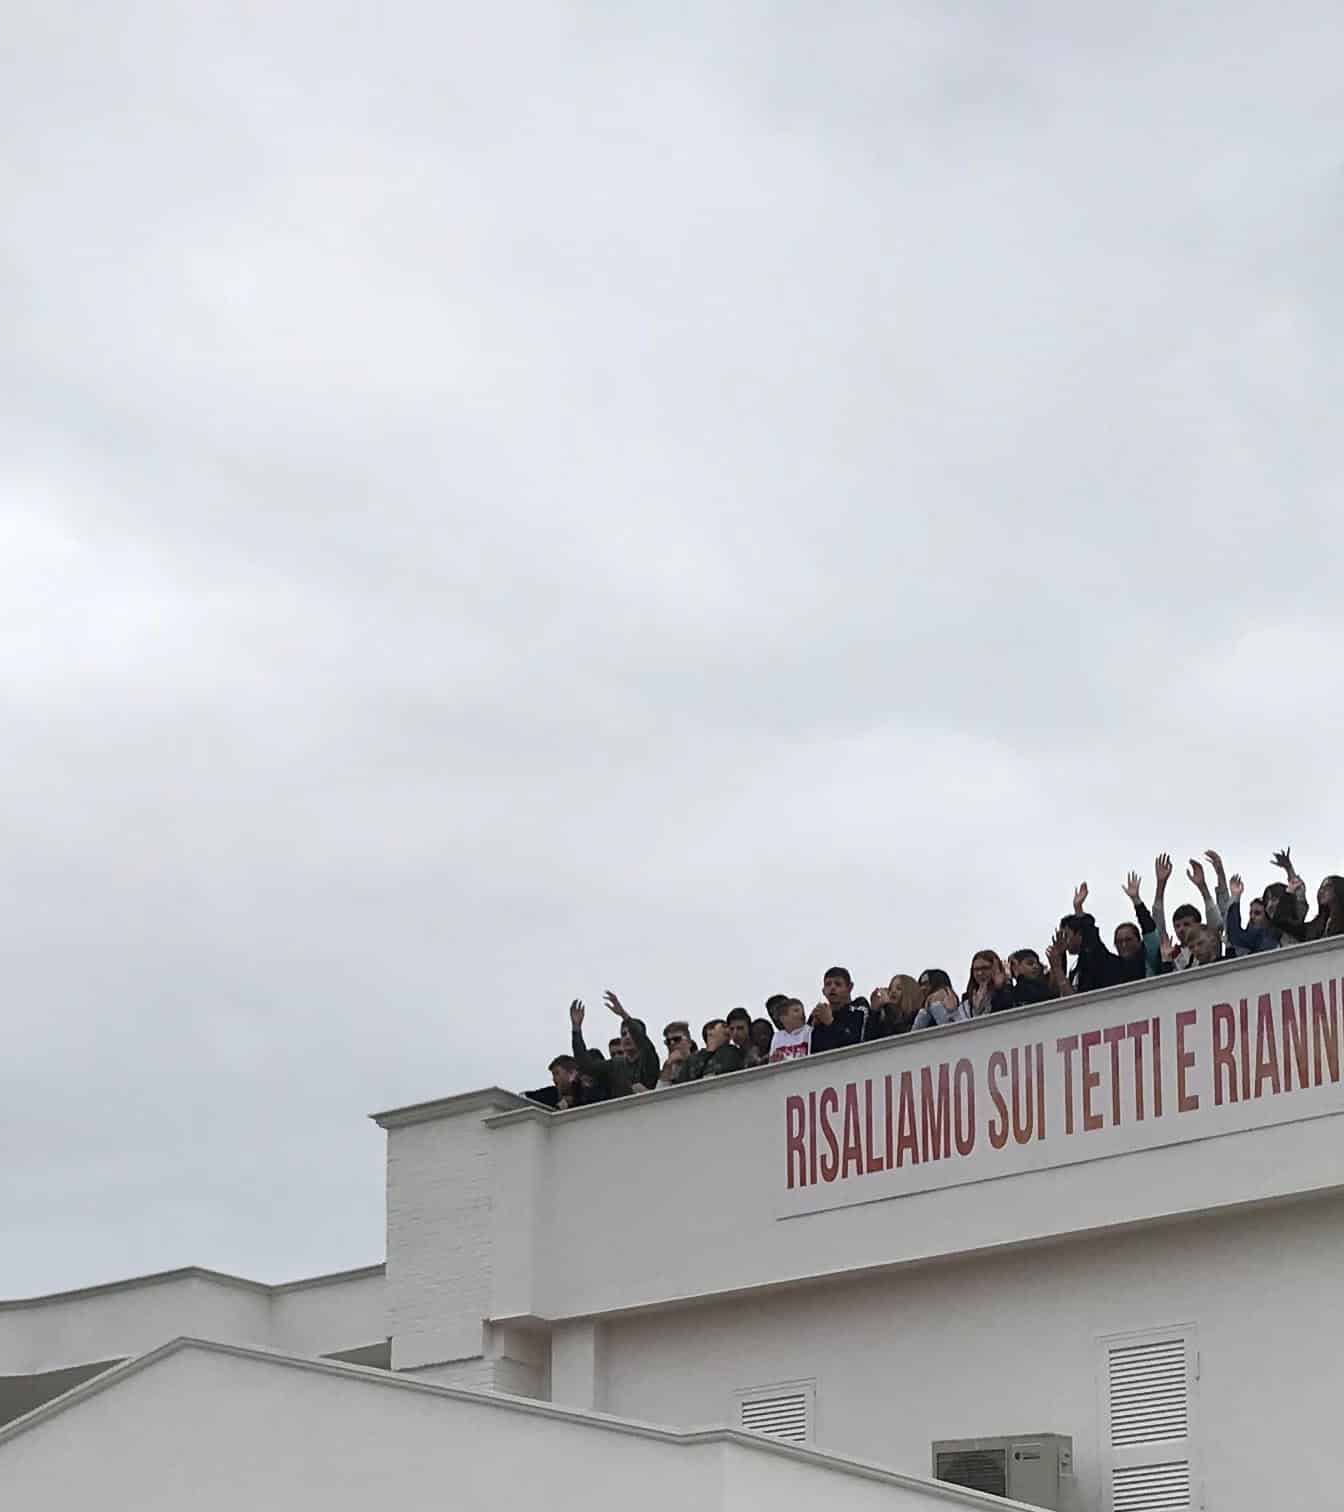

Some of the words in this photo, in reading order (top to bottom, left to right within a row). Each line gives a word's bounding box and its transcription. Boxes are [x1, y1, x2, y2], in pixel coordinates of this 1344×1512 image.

[785, 1058, 976, 1189] RISALIAMO
[987, 1042, 1045, 1149] SUI
[1056, 1017, 1162, 1135] TETTI
[1175, 1009, 1199, 1113] E
